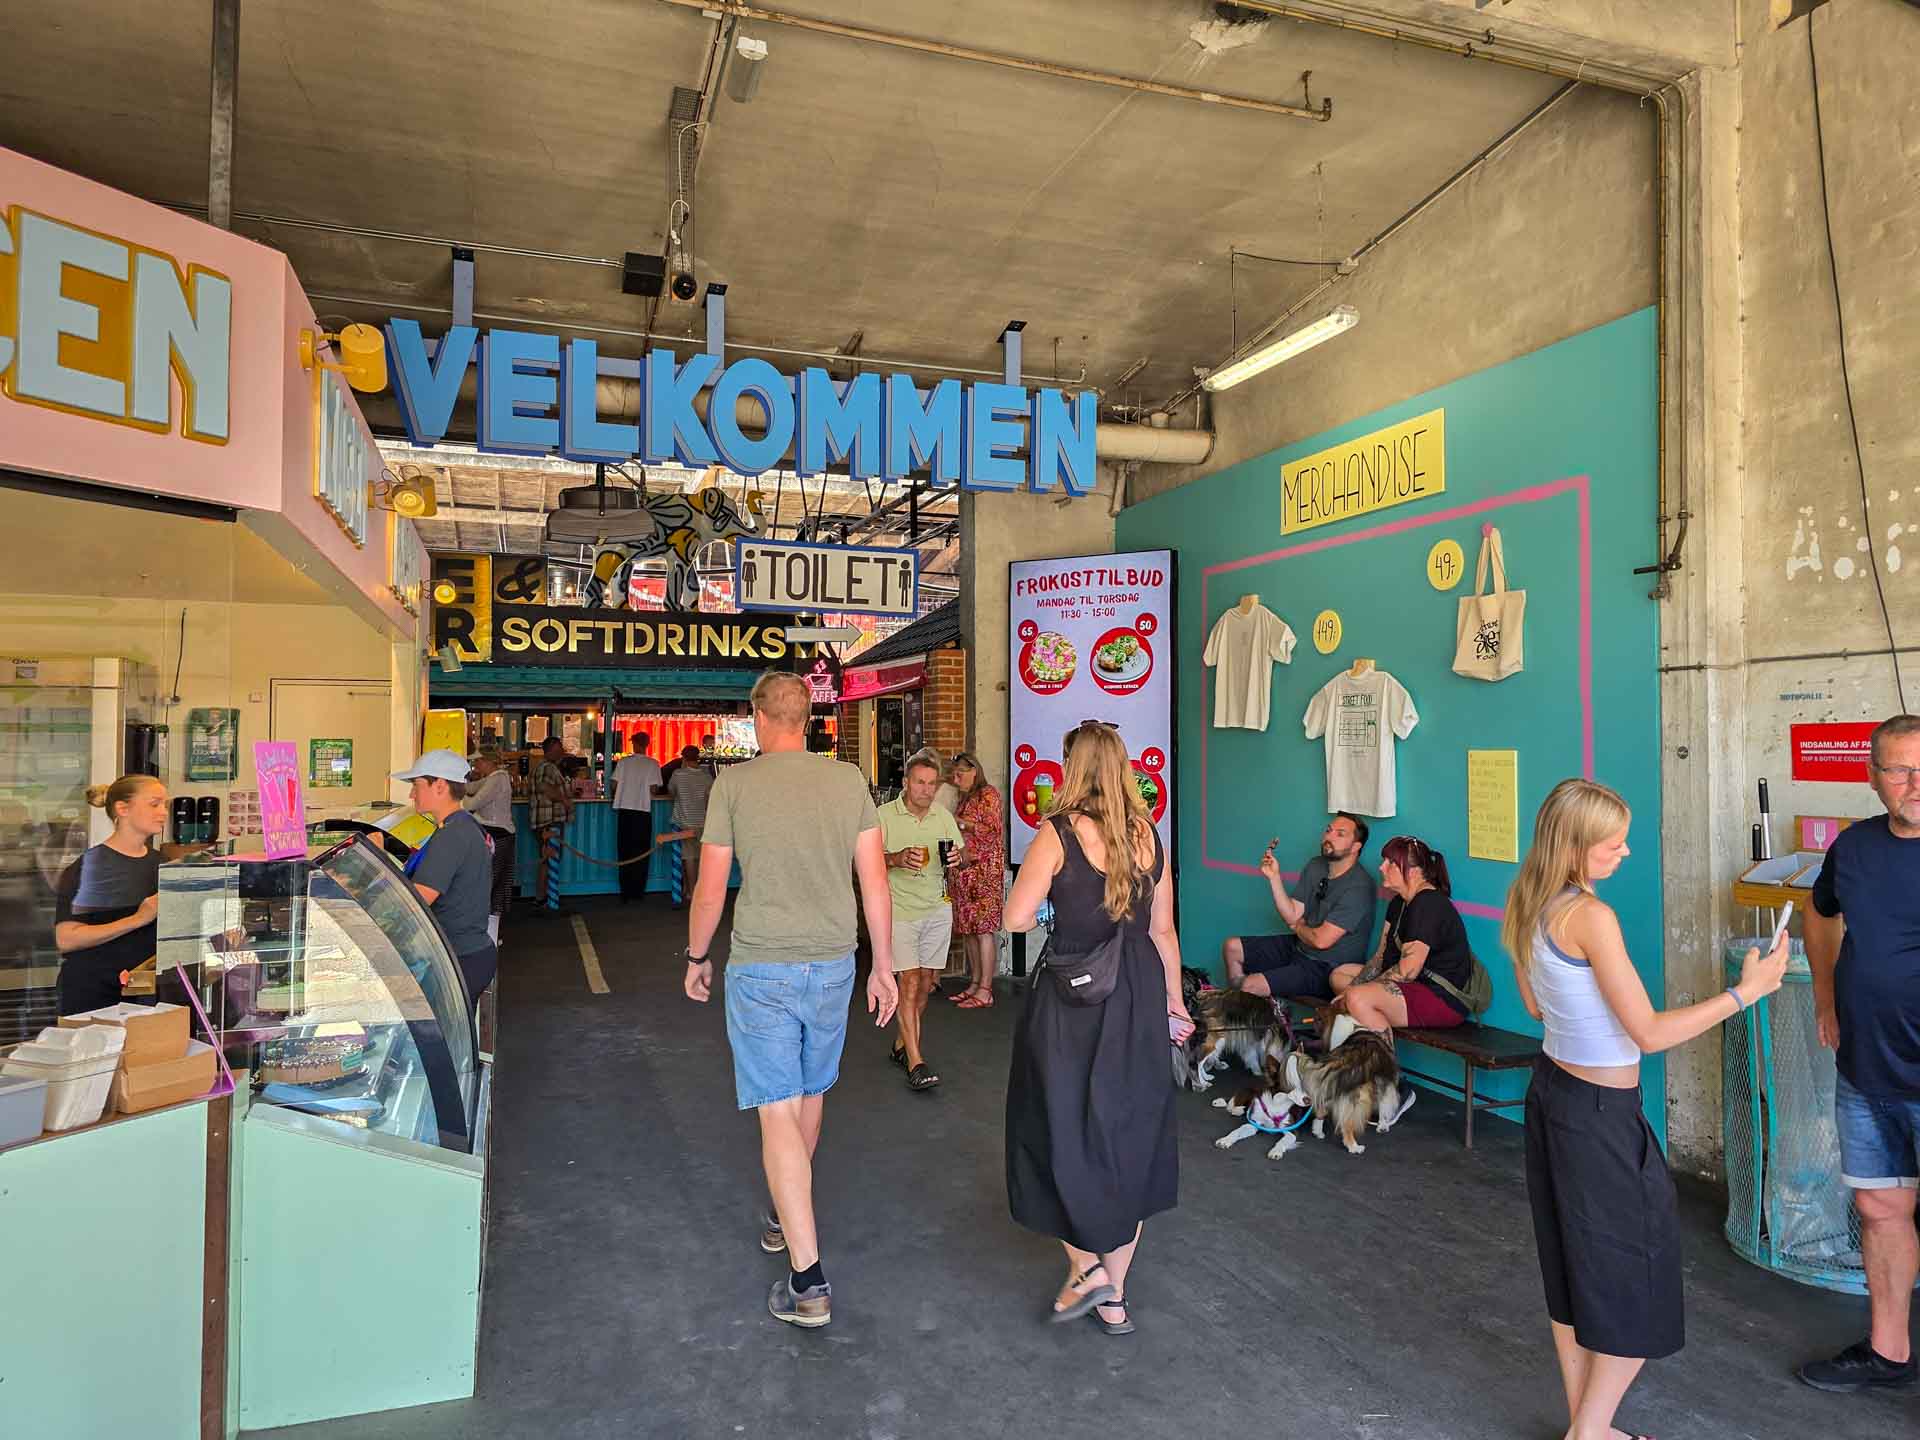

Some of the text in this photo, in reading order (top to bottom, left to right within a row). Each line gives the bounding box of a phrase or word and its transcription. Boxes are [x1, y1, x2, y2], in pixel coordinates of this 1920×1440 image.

[0, 205, 232, 446] EN
[385, 318, 1099, 498] VELKOMMEN
[1282, 428, 1429, 528] MERCHANDISE
[759, 549, 897, 606] TOILET
[1036, 592, 1140, 609] MANDAG TIL TORSDAG
[1060, 609, 1081, 620] 11:30
[1092, 607, 1116, 618] 15:00
[501, 615, 787, 659] SOFTDRINKS
[810, 690, 838, 703] AFFE
[1800, 741, 1849, 749] INDSAMLING
